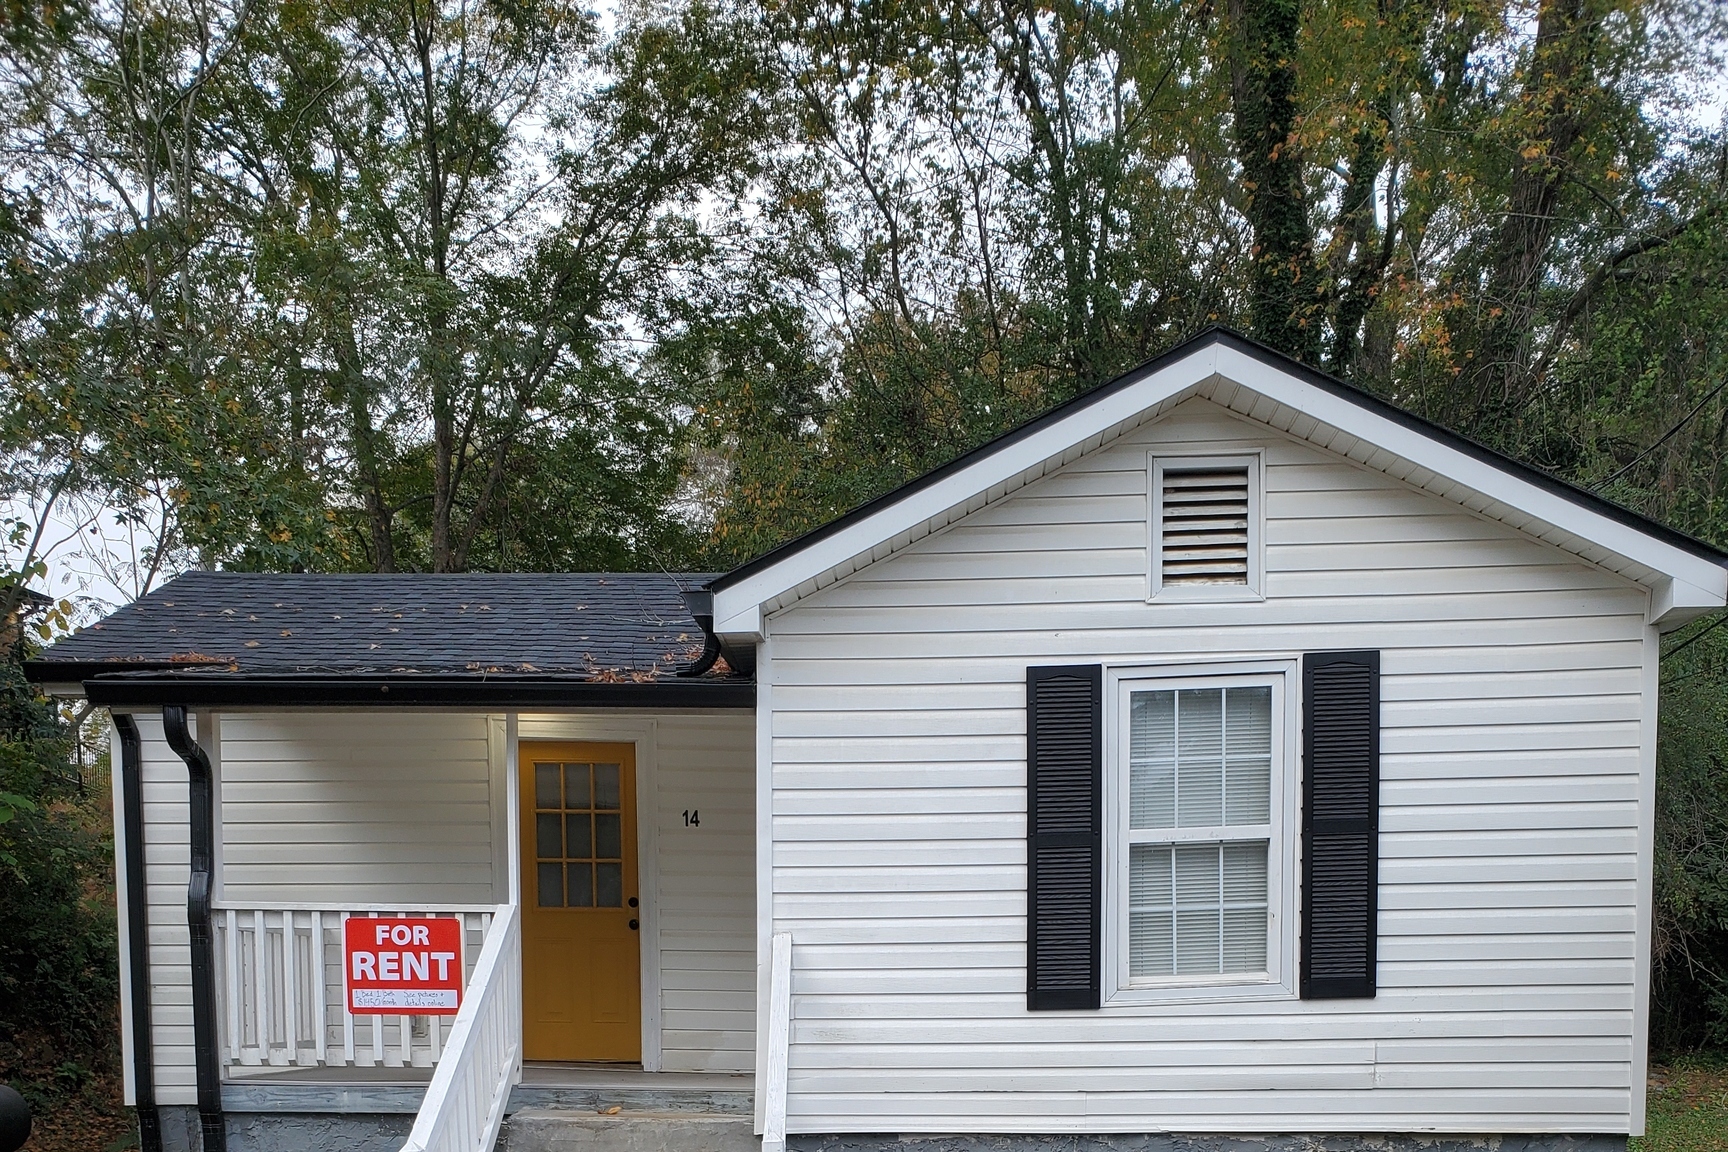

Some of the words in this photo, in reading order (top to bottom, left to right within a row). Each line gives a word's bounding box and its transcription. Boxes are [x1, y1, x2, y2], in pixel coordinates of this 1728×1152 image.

[682, 809, 700, 827] 14
[375, 924, 430, 946] FOR
[352, 951, 455, 981] RENT
